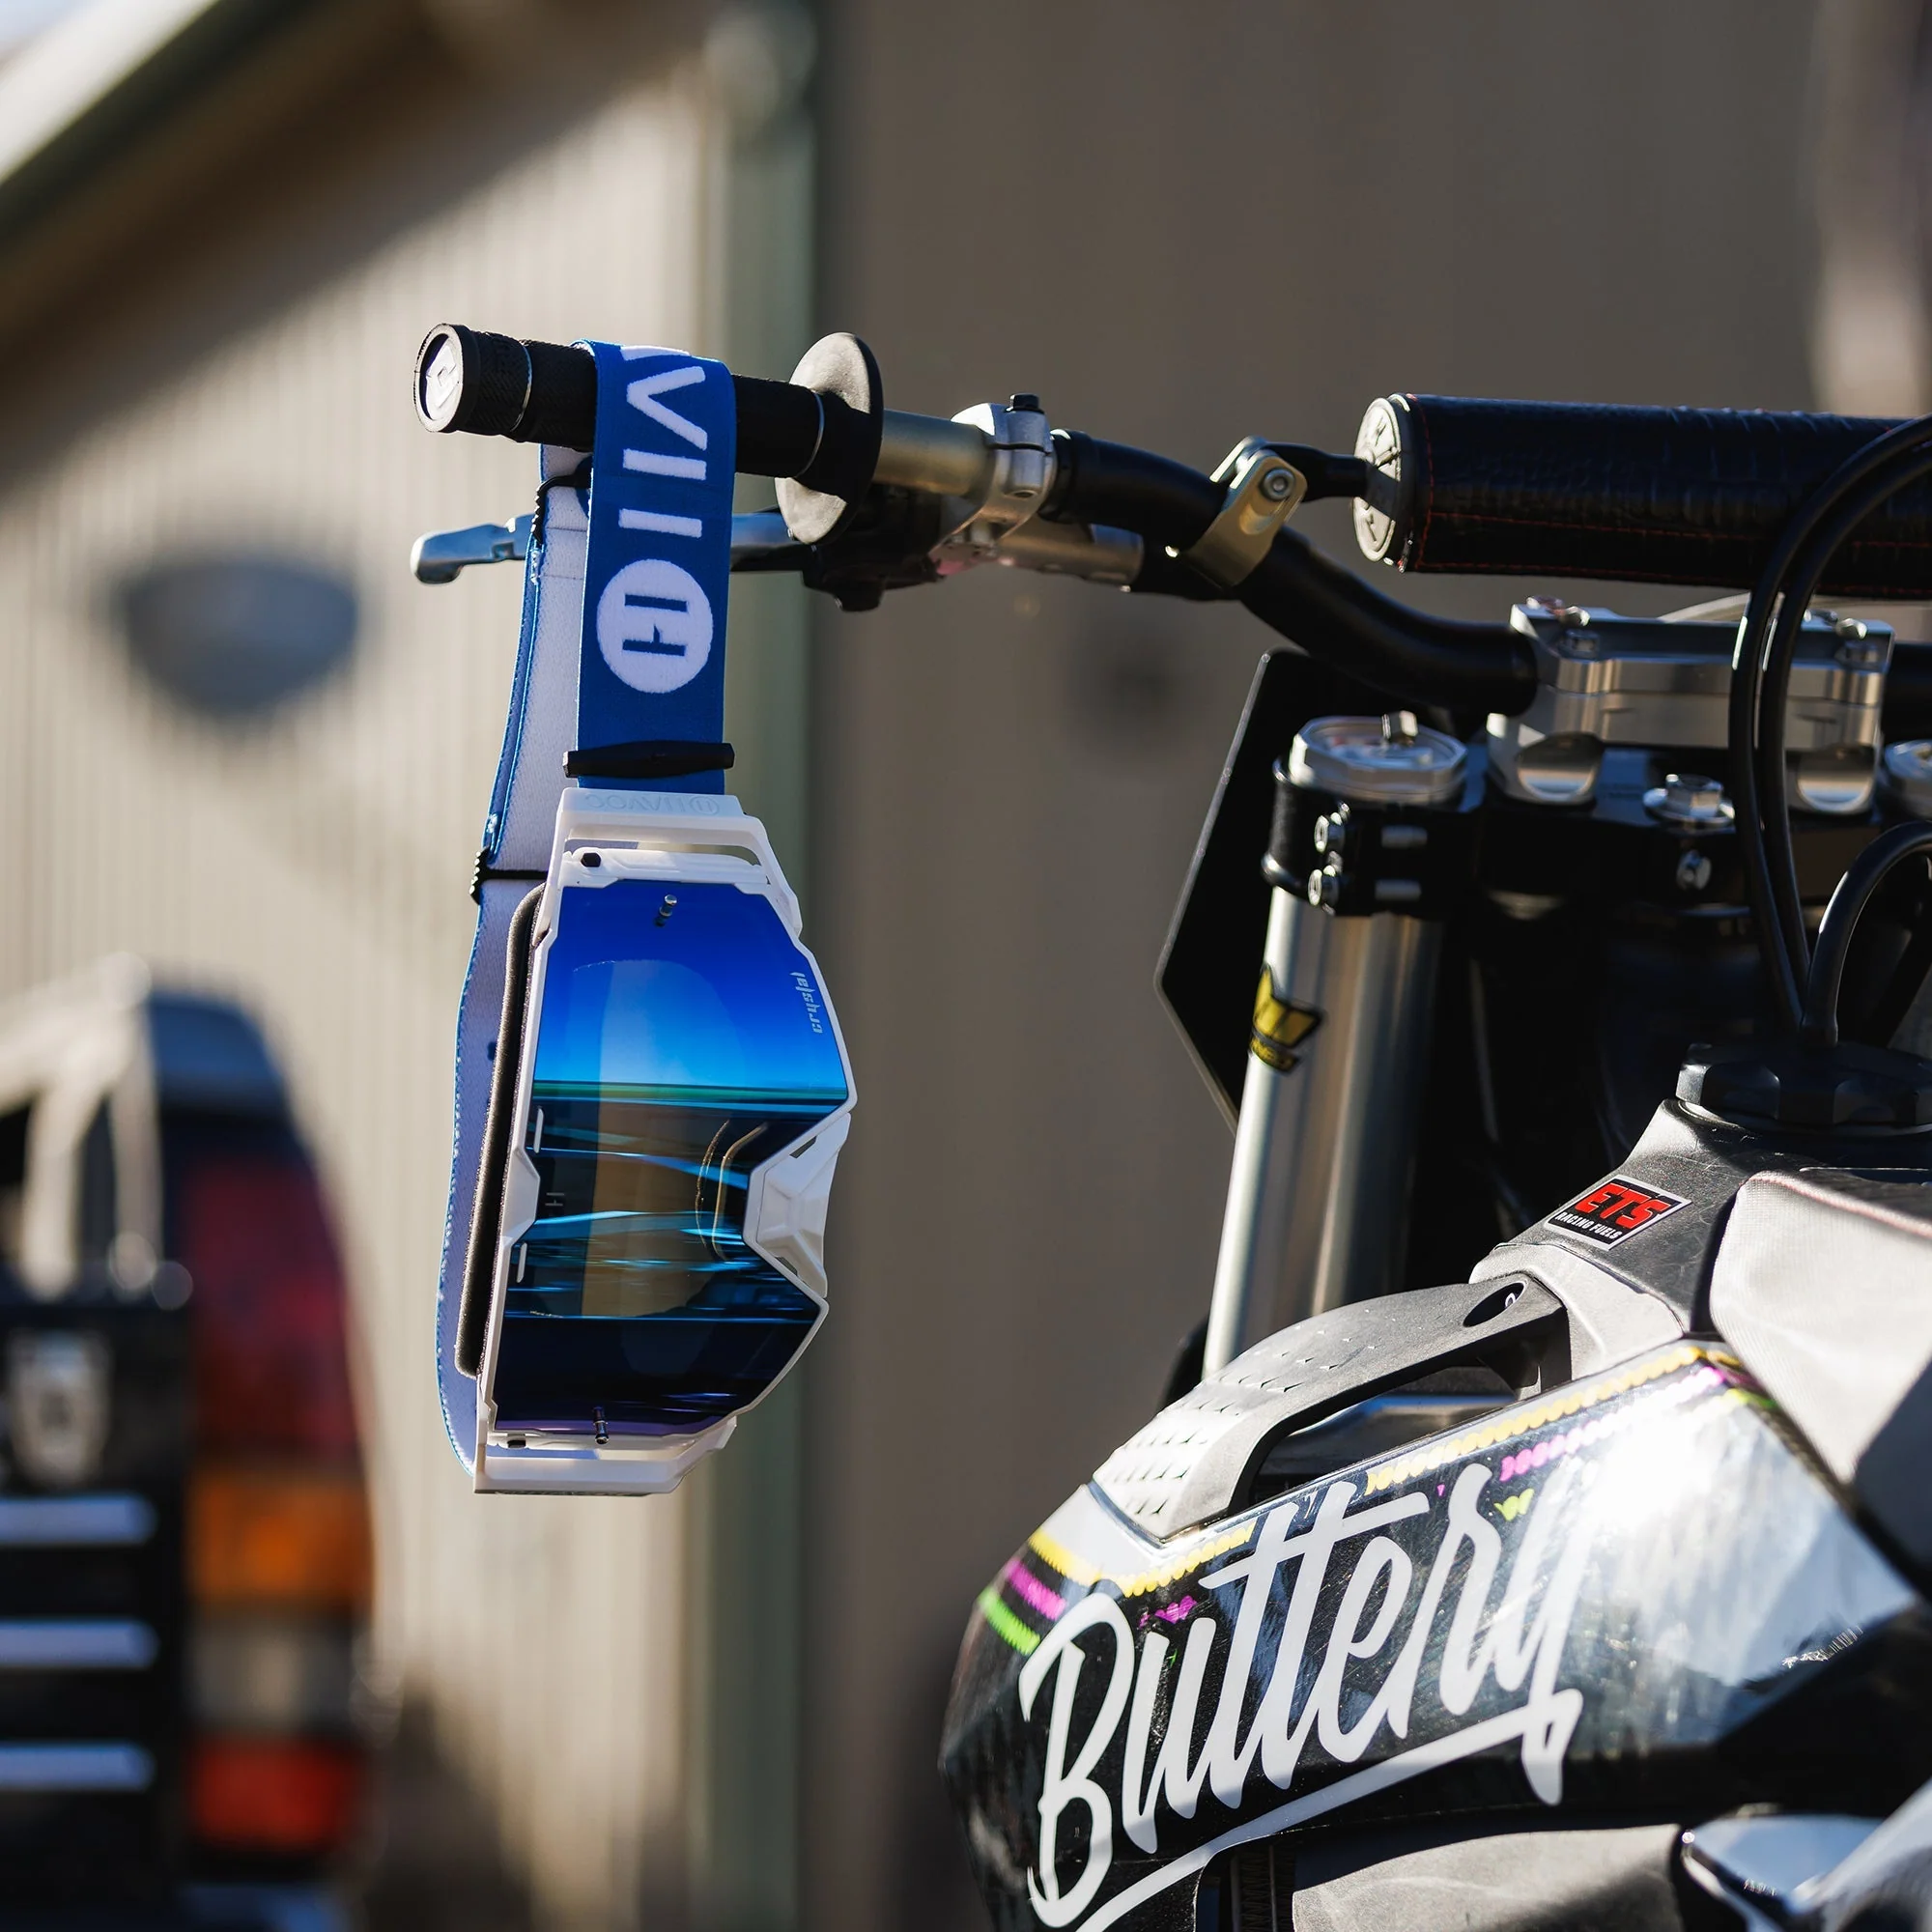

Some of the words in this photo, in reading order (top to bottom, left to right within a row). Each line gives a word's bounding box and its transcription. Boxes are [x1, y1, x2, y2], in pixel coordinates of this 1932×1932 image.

[790, 971, 823, 1035] crystal
[1554, 1211, 1594, 1230] RACING
[1589, 1223, 1623, 1239] FUELS
[1574, 1182, 1672, 1230] ETS
[1019, 1461, 1598, 1931] Buttery
